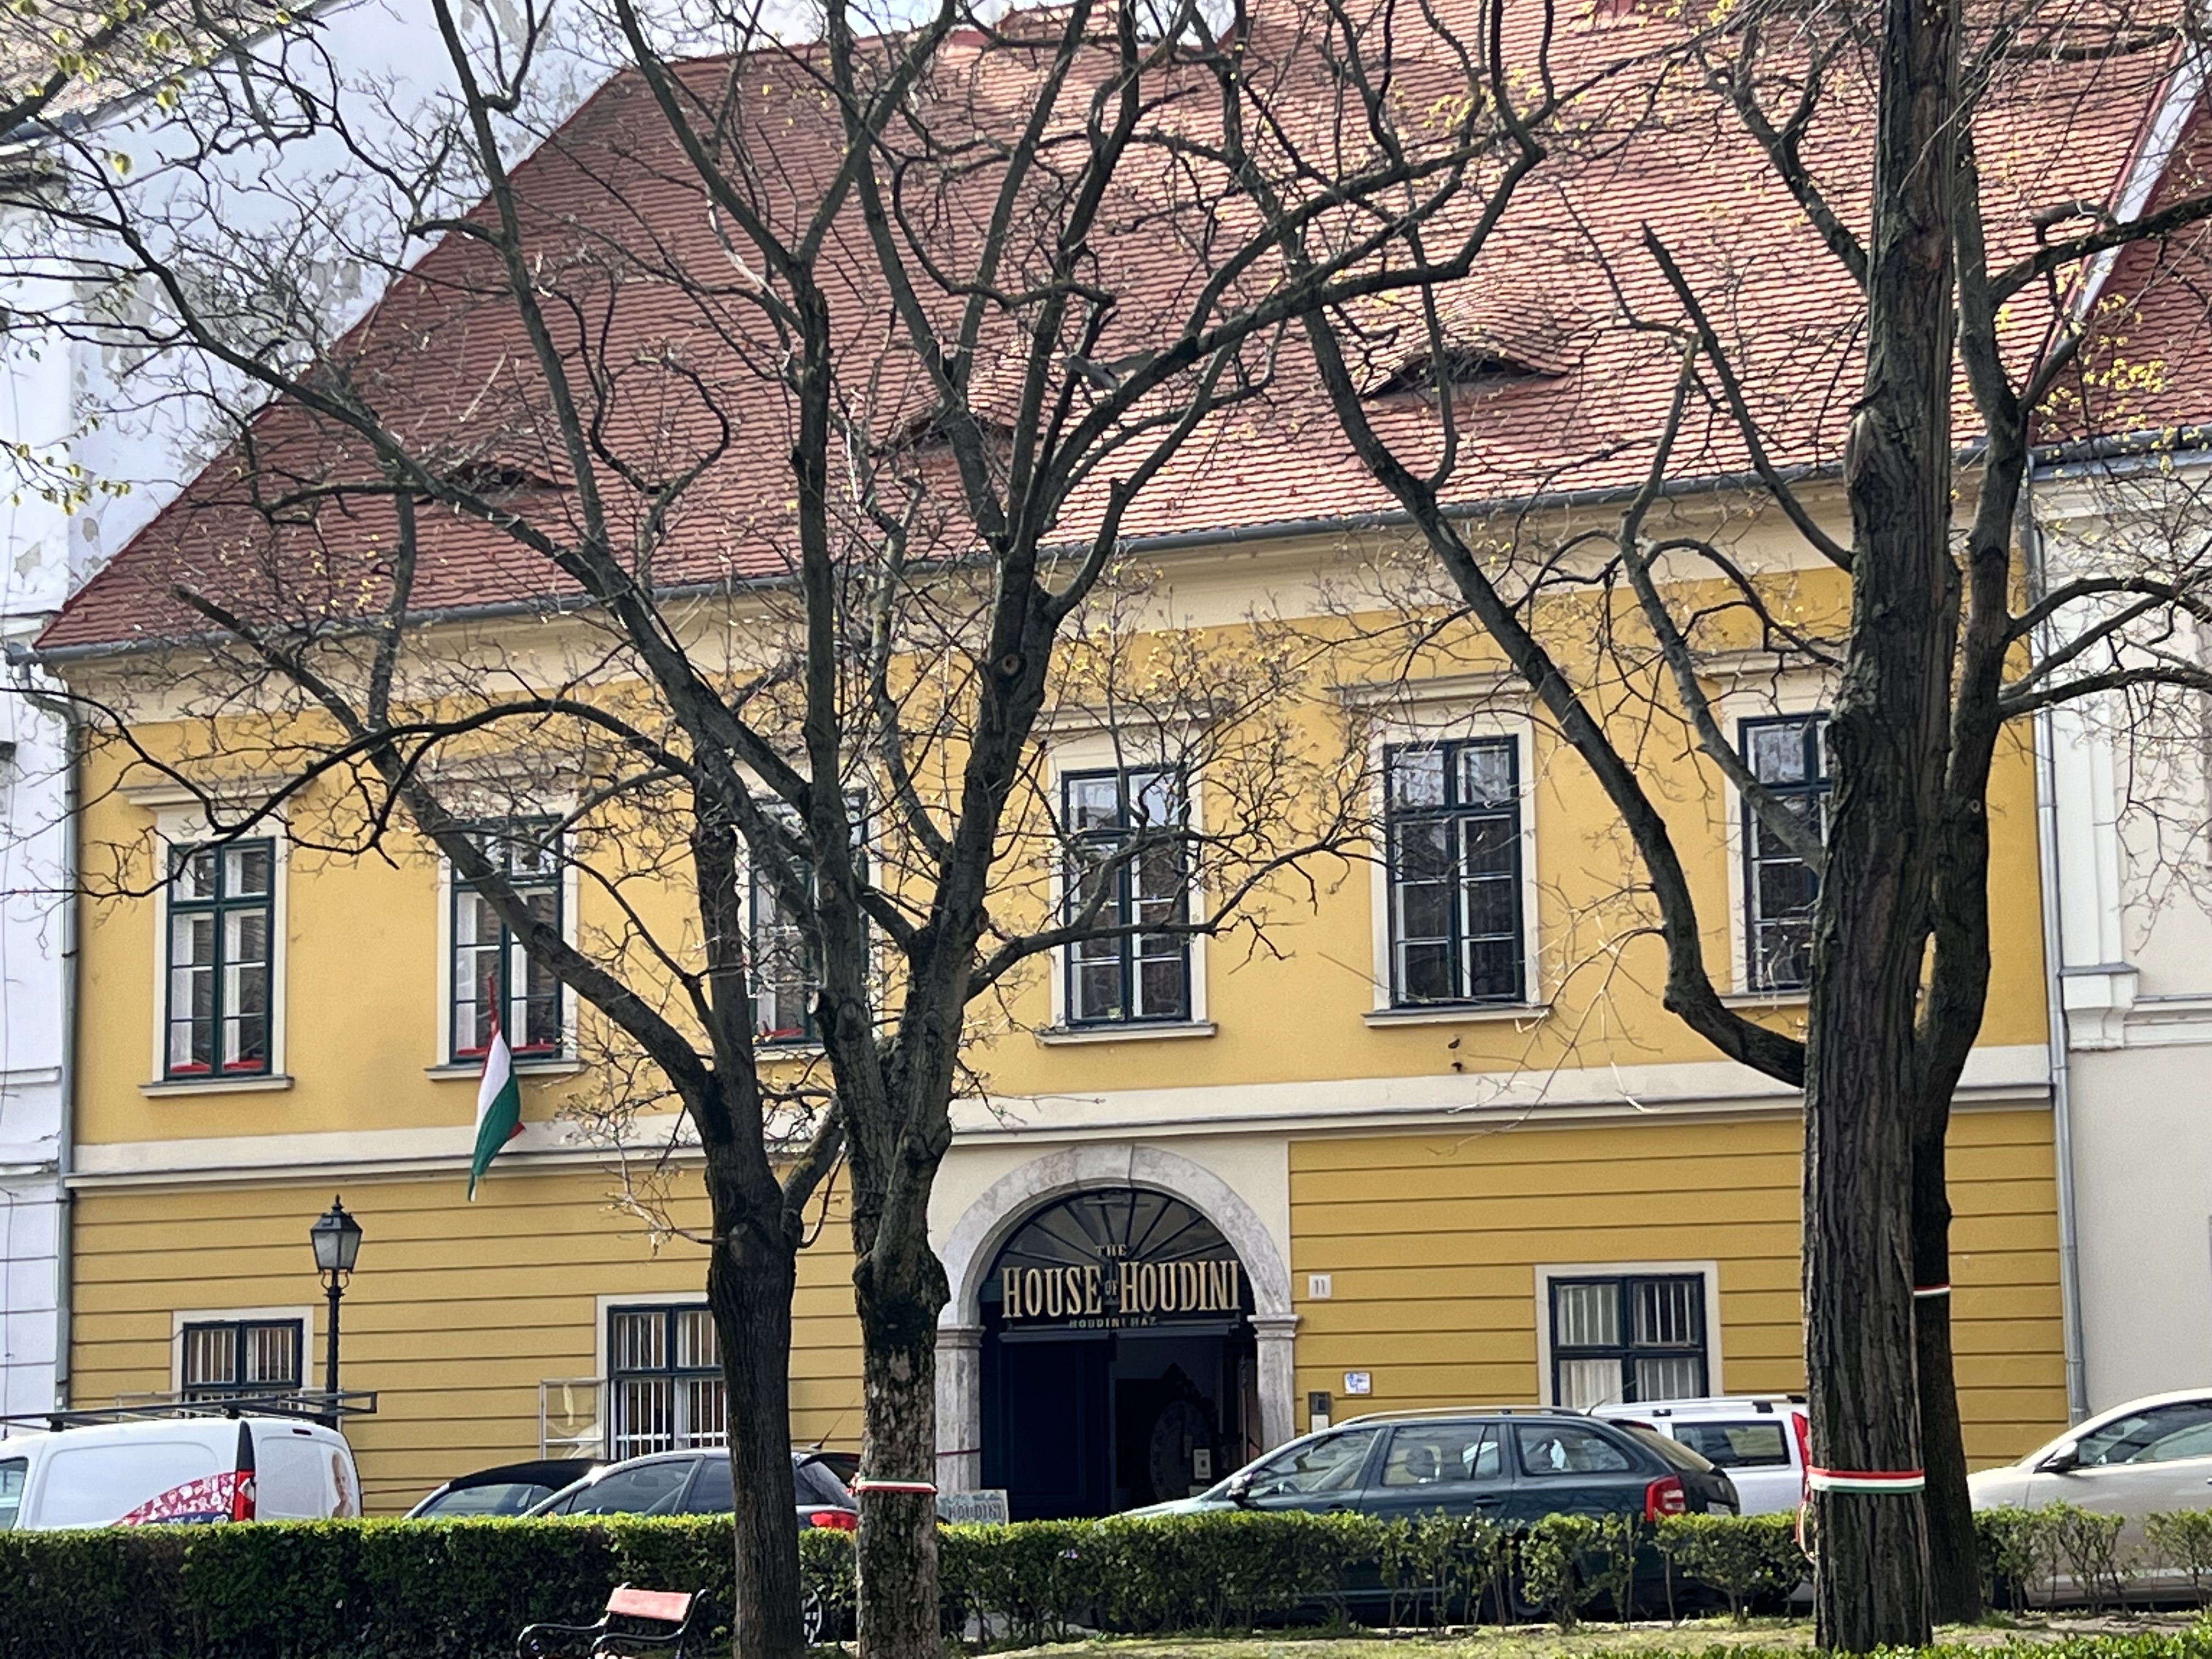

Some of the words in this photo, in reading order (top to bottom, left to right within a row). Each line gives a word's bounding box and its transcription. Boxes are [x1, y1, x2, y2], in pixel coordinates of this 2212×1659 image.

[1095, 1244, 1127, 1257] THE
[1001, 1265, 1102, 1319] HOUSE
[1104, 1280, 1119, 1296] OF
[1118, 1260, 1242, 1313] HOUDINI
[1314, 1279, 1325, 1294] 11
[1069, 1318, 1126, 1329] HOUDINI
